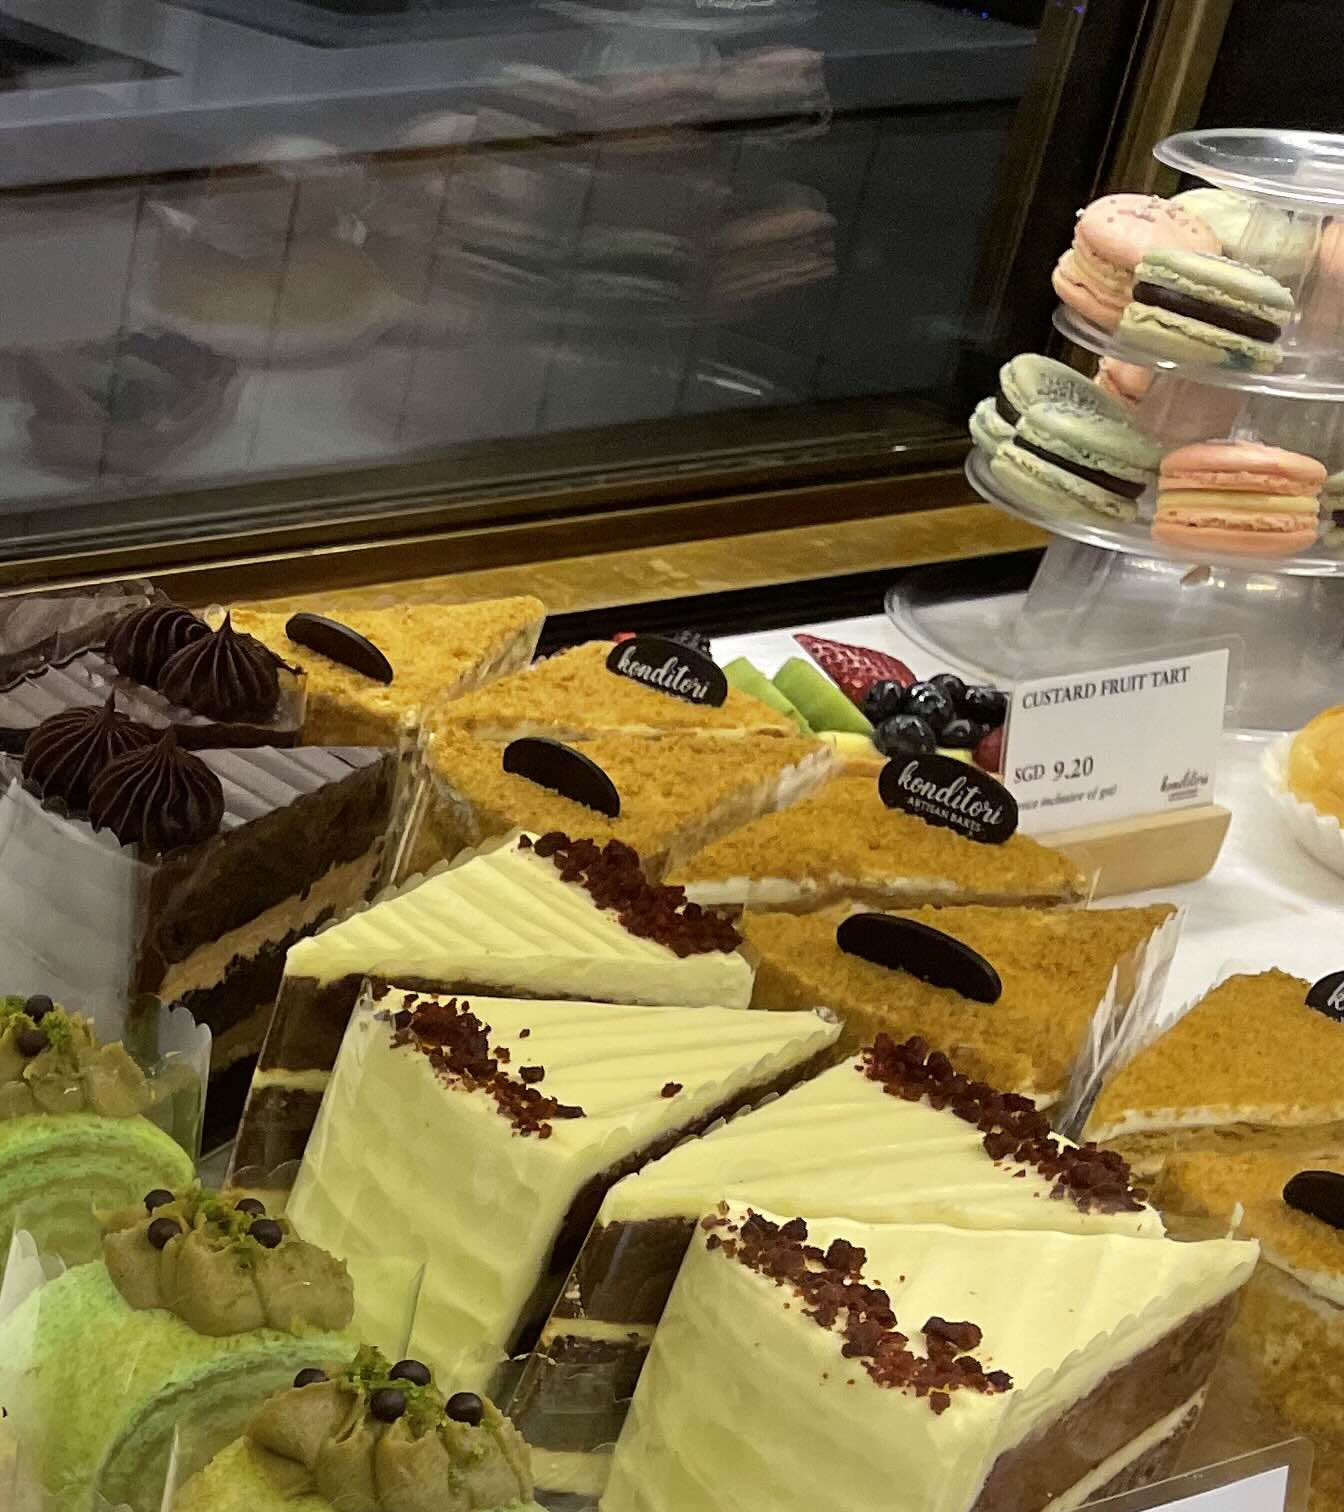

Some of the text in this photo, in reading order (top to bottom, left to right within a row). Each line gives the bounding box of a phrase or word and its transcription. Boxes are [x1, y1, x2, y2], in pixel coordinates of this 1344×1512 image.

[617, 646, 709, 698] konditori
[1022, 666, 1191, 709] CUSTARD FRUIT TART
[1014, 756, 1094, 784] SGD 9.20
[898, 760, 1002, 824] konditori
[908, 797, 949, 818] ARTISAN
